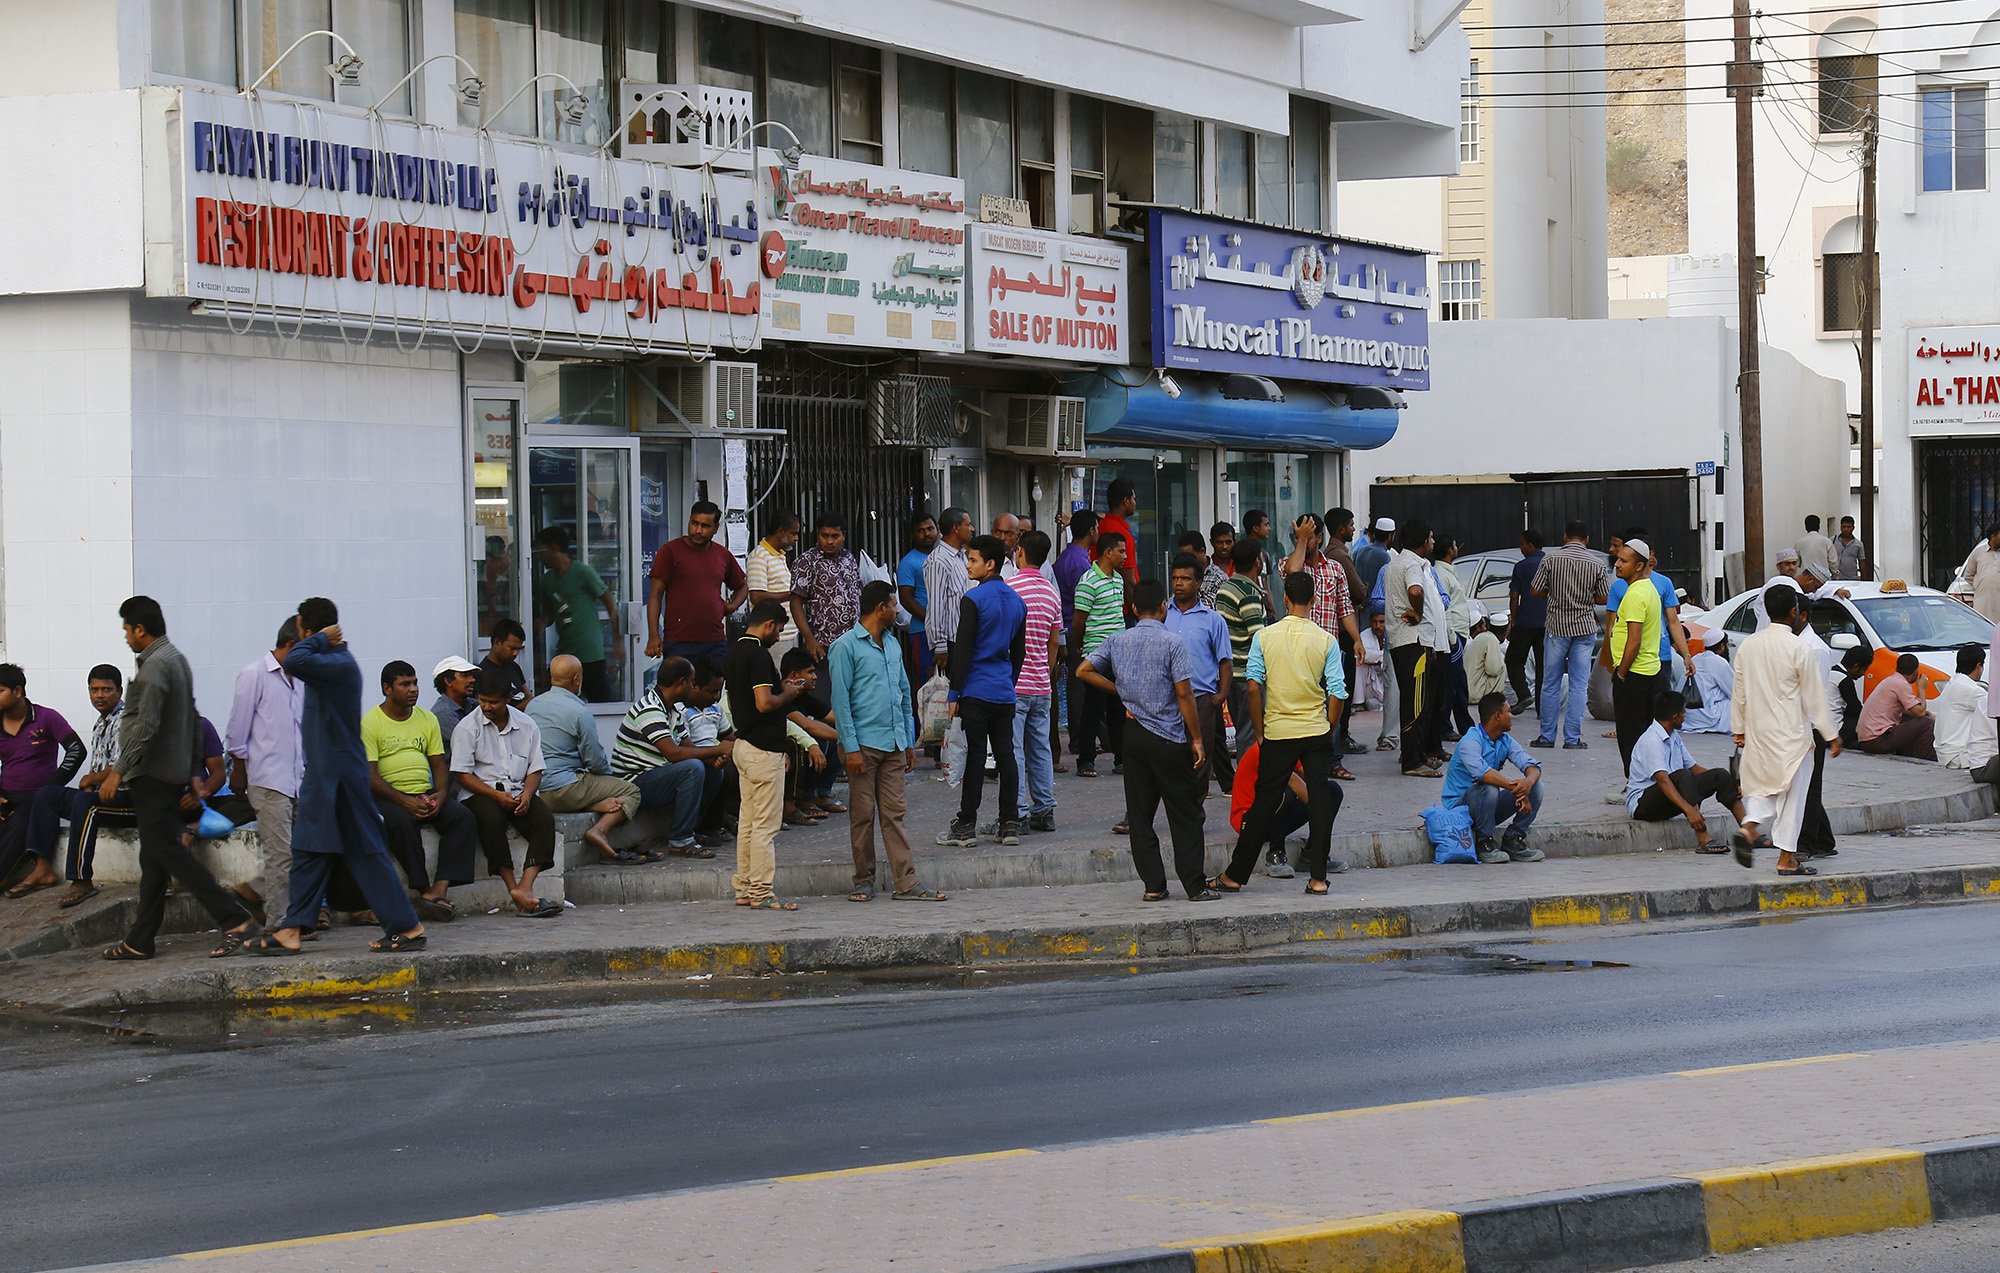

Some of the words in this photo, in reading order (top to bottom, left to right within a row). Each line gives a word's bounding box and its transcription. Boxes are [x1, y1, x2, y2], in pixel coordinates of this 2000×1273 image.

[351, 147, 456, 207] TRADING
[457, 164, 498, 213] LLC
[792, 202, 848, 230] Oman
[849, 211, 904, 239] Travel
[902, 218, 963, 246] Bureau
[918, 191, 964, 214] مكتب
[196, 197, 350, 278] RESTAURANT
[352, 217, 374, 282] &
[373, 220, 457, 291] COFFEE
[457, 231, 515, 296] SHOP
[785, 240, 848, 272] Biman
[1198, 233, 1296, 291] مسقط
[648, 256, 760, 324] مطعم
[776, 273, 826, 293] BANGLADESH
[826, 277, 860, 297] AIRLINES
[988, 263, 1071, 306] اللحوم
[1075, 275, 1116, 316] بيع
[989, 309, 1029, 342] SALE
[1031, 315, 1053, 344] OF
[1056, 318, 1118, 351] MUTTON
[1172, 304, 1280, 356] Muscat
[1280, 317, 1405, 377] Pharmacy
